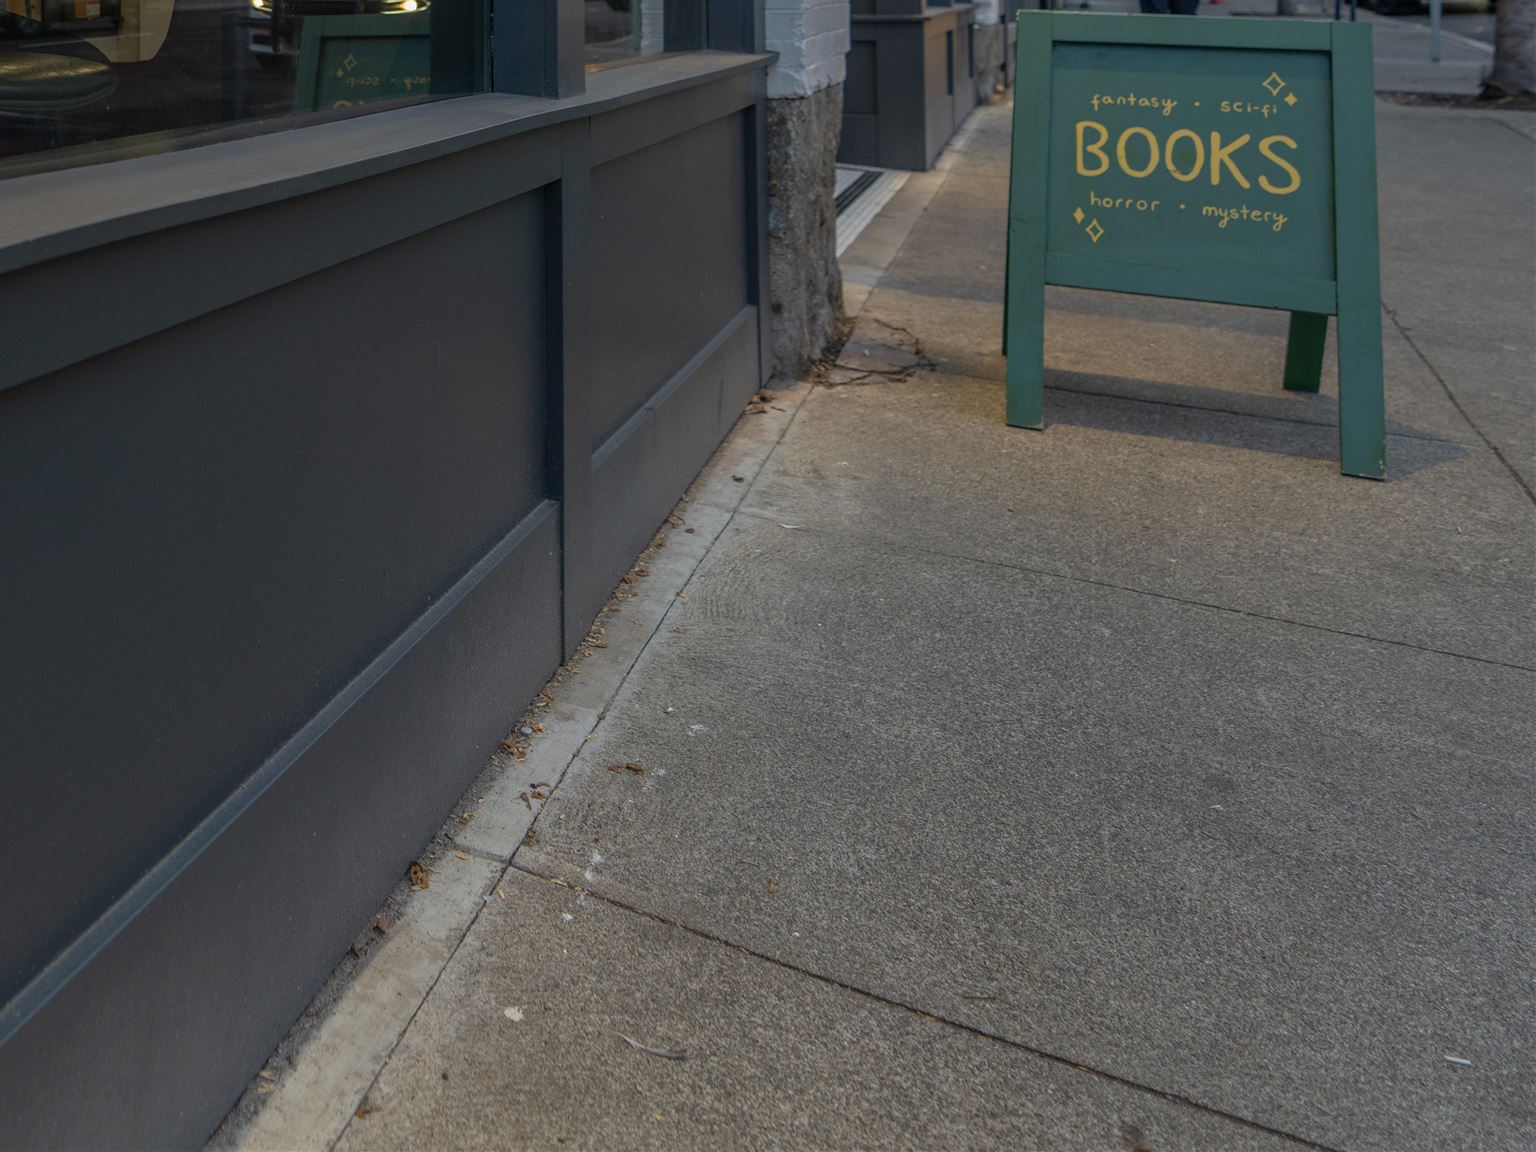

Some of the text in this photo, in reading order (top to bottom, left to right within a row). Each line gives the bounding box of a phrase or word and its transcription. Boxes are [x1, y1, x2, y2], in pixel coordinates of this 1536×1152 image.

[1090, 92, 1278, 119] fantasy sci-fi
[1075, 119, 1302, 195] BOOKS
[1089, 190, 1289, 232] horror mystery
